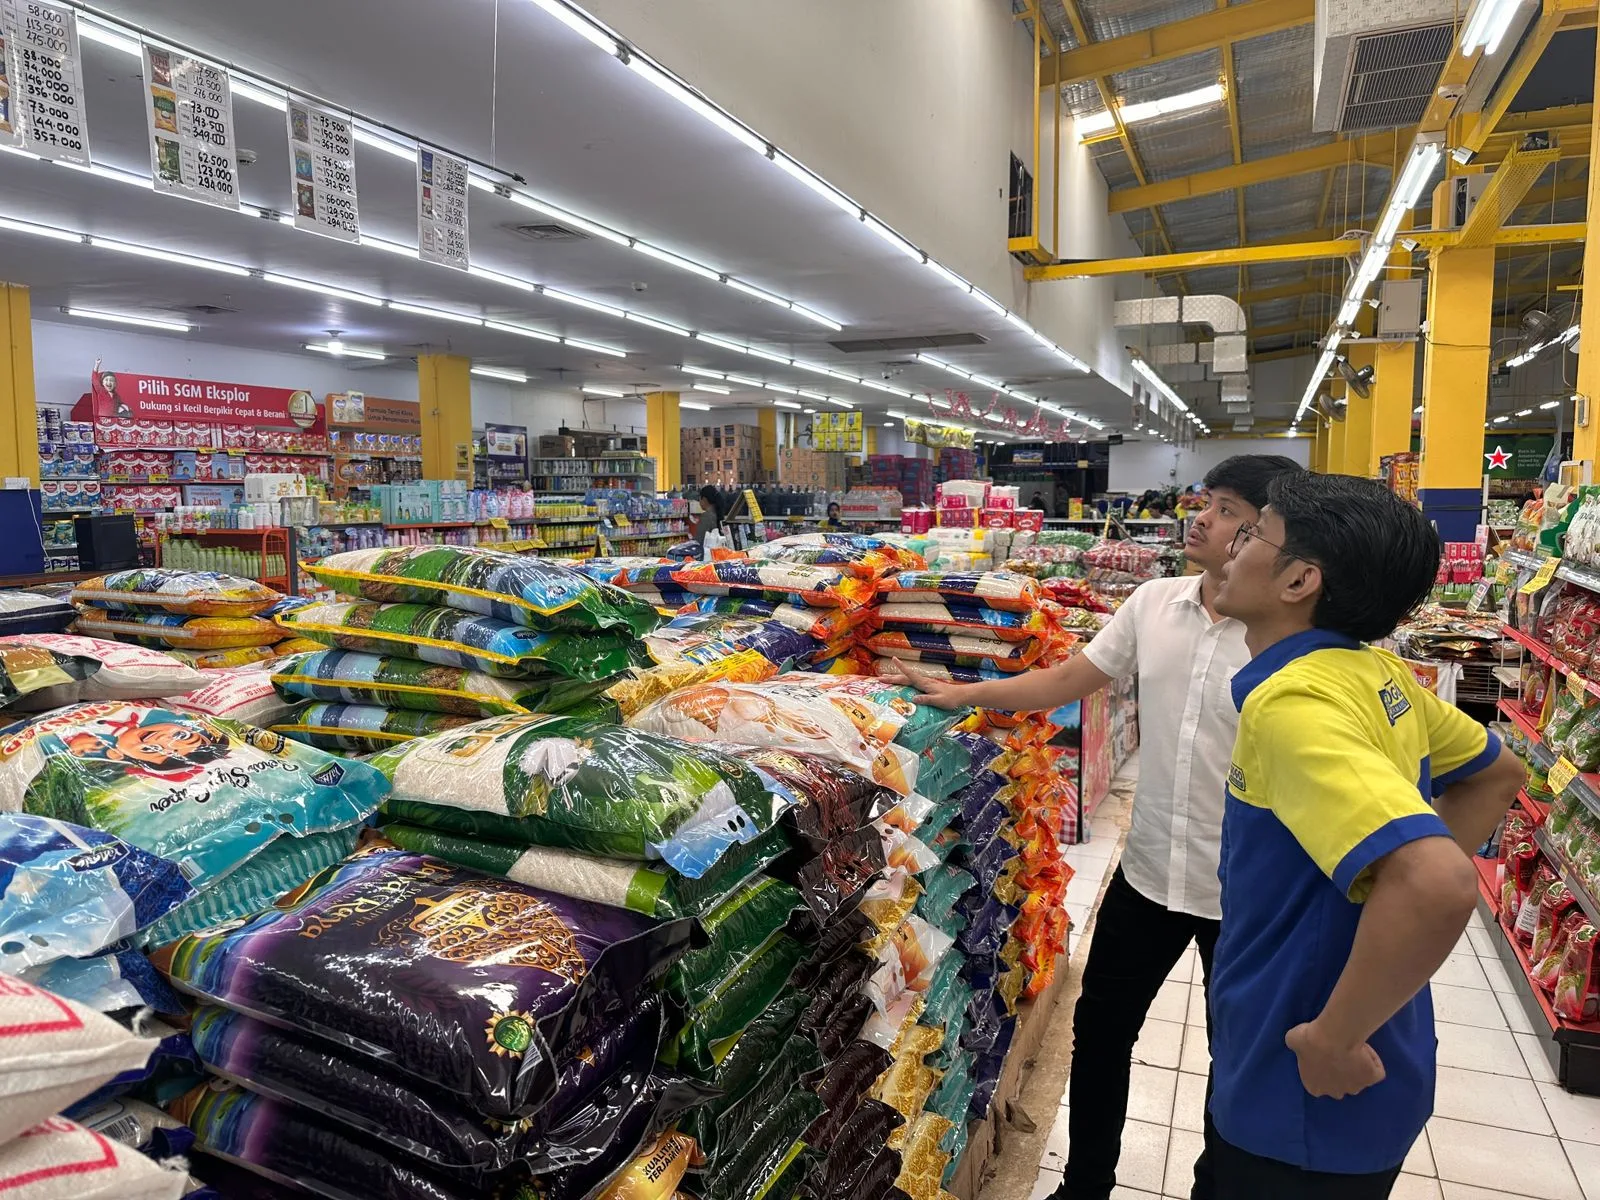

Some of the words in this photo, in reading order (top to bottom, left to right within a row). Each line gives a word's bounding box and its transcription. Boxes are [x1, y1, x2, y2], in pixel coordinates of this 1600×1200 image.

[28, 4, 62, 23] 58.000
[26, 29, 67, 53] 275.000
[23, 49, 61, 69] 38.000
[24, 61, 62, 81] 74.000
[25, 73, 69, 93] 146.000
[28, 84, 74, 105] 356.000
[28, 99, 69, 120] 73.000
[33, 114, 79, 136] 144.000
[33, 128, 82, 150] 357.000
[198, 151, 228, 169] 62.500
[198, 164, 232, 182] 123.000
[139, 380, 169, 396] Pilih
[174, 383, 202, 398] SGM
[206, 386, 250, 404] Eksplor
[139, 401, 172, 412] Dukung
[174, 402, 181, 411] si
[183, 403, 201, 413] Kecil
[204, 405, 233, 417] Berpikir
[235, 407, 254, 418] Cepat
[256, 409, 262, 417] &
[263, 409, 285, 419] Berani
